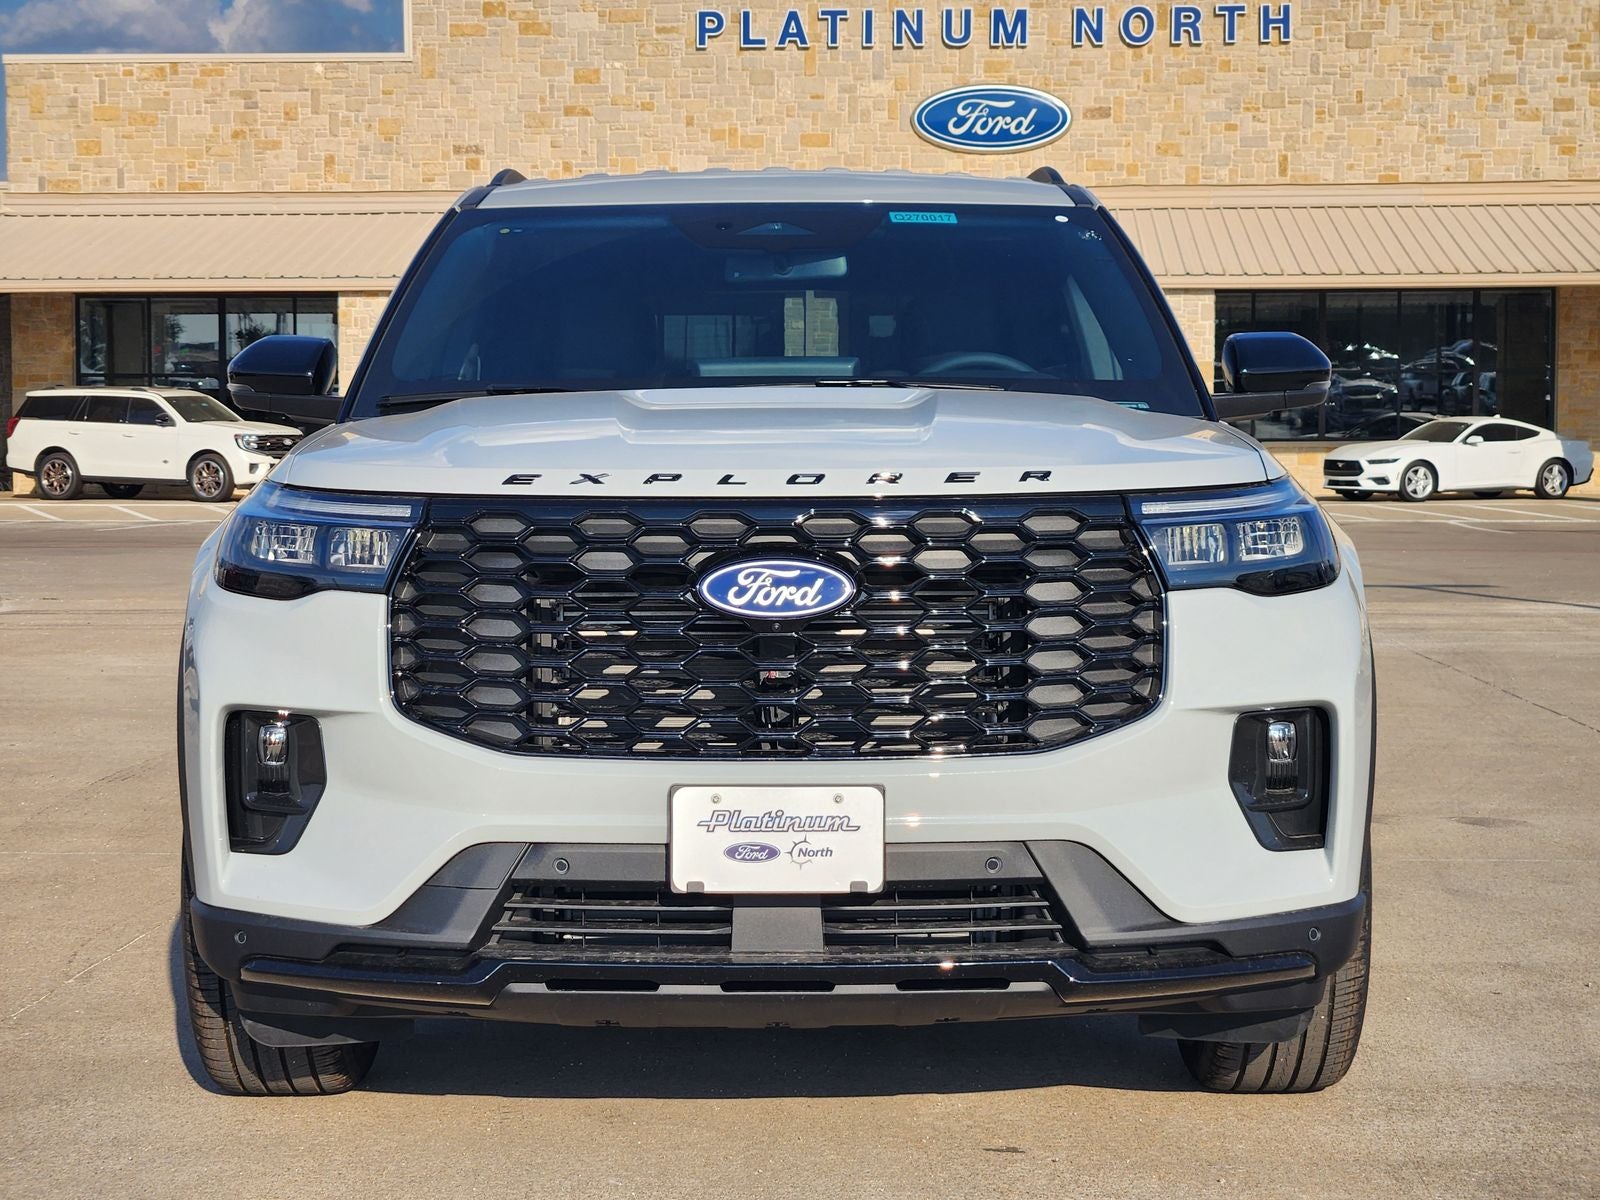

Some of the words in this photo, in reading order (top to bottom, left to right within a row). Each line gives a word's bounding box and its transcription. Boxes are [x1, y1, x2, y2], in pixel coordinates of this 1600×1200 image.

[696, 7, 1028, 49] PLATINUM
[1073, 4, 1293, 48] NORTH
[947, 99, 1036, 137] Ford
[501, 469, 1053, 486] EXPLORER
[727, 566, 822, 607] Ford
[697, 810, 861, 833] Platinum
[734, 845, 769, 860] Ford
[798, 846, 833, 858] North
